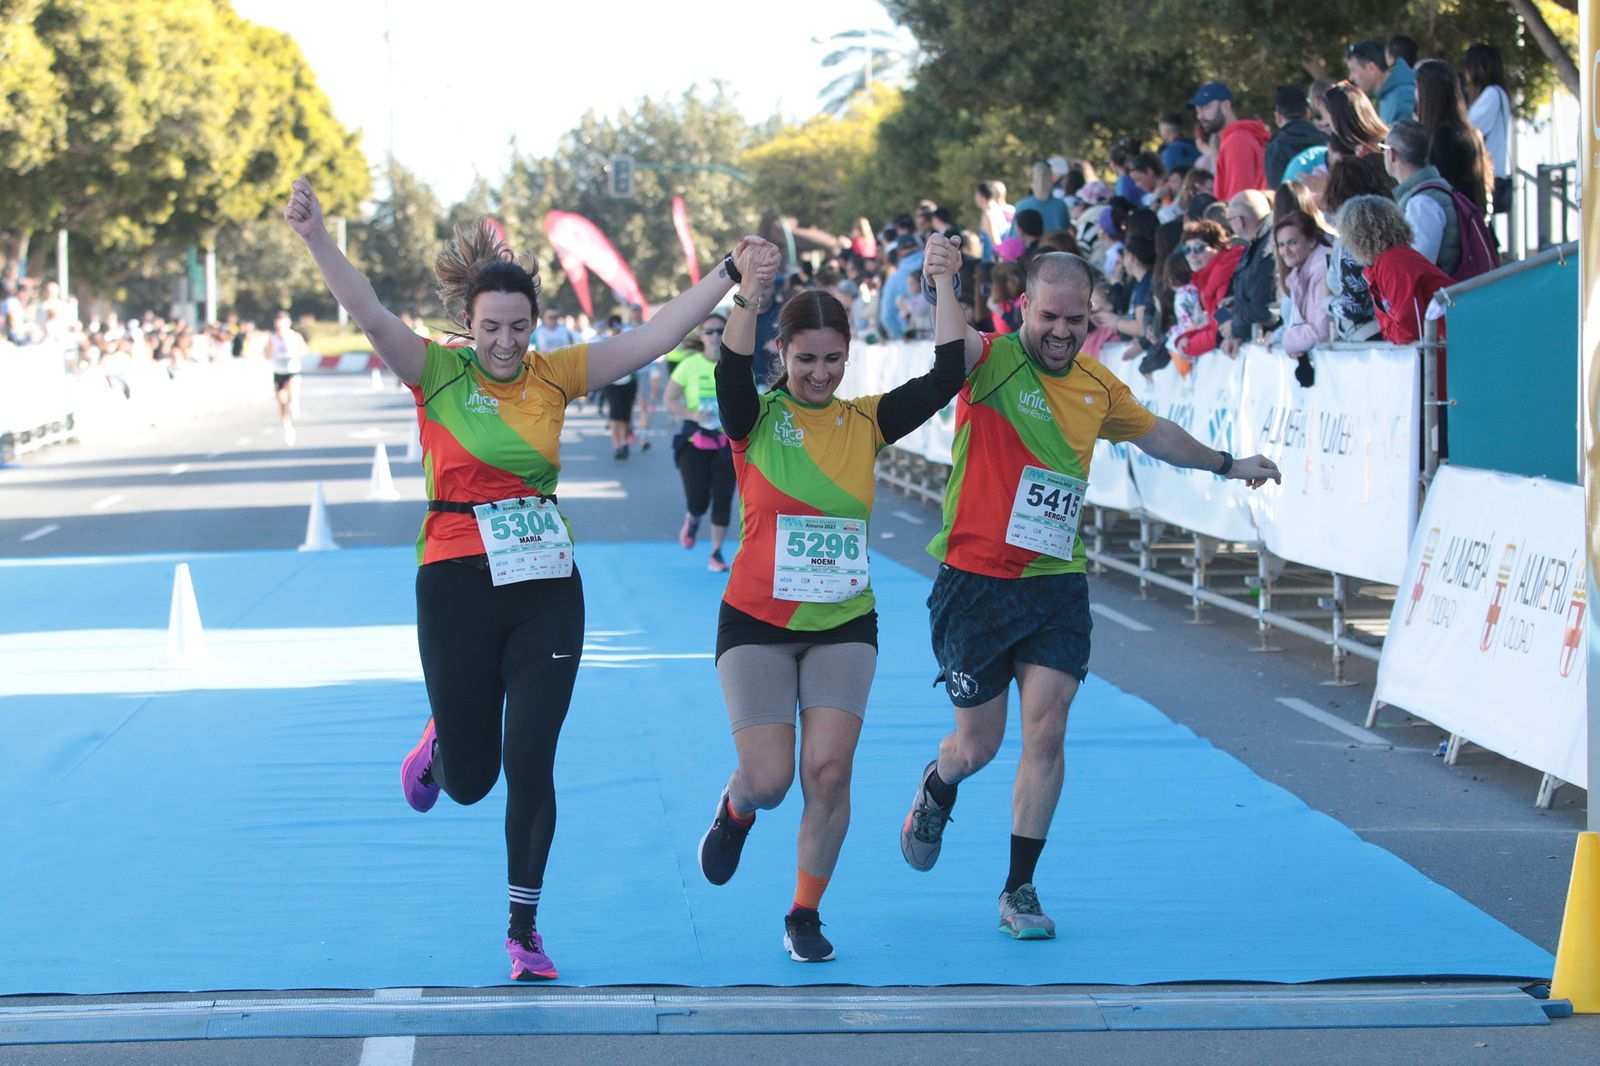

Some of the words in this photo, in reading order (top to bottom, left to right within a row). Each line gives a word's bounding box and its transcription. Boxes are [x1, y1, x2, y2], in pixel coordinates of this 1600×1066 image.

[1026, 482, 1080, 518] 5415
[490, 510, 559, 540] 5304
[1044, 510, 1066, 522] SERGIO
[787, 532, 859, 560] 5296
